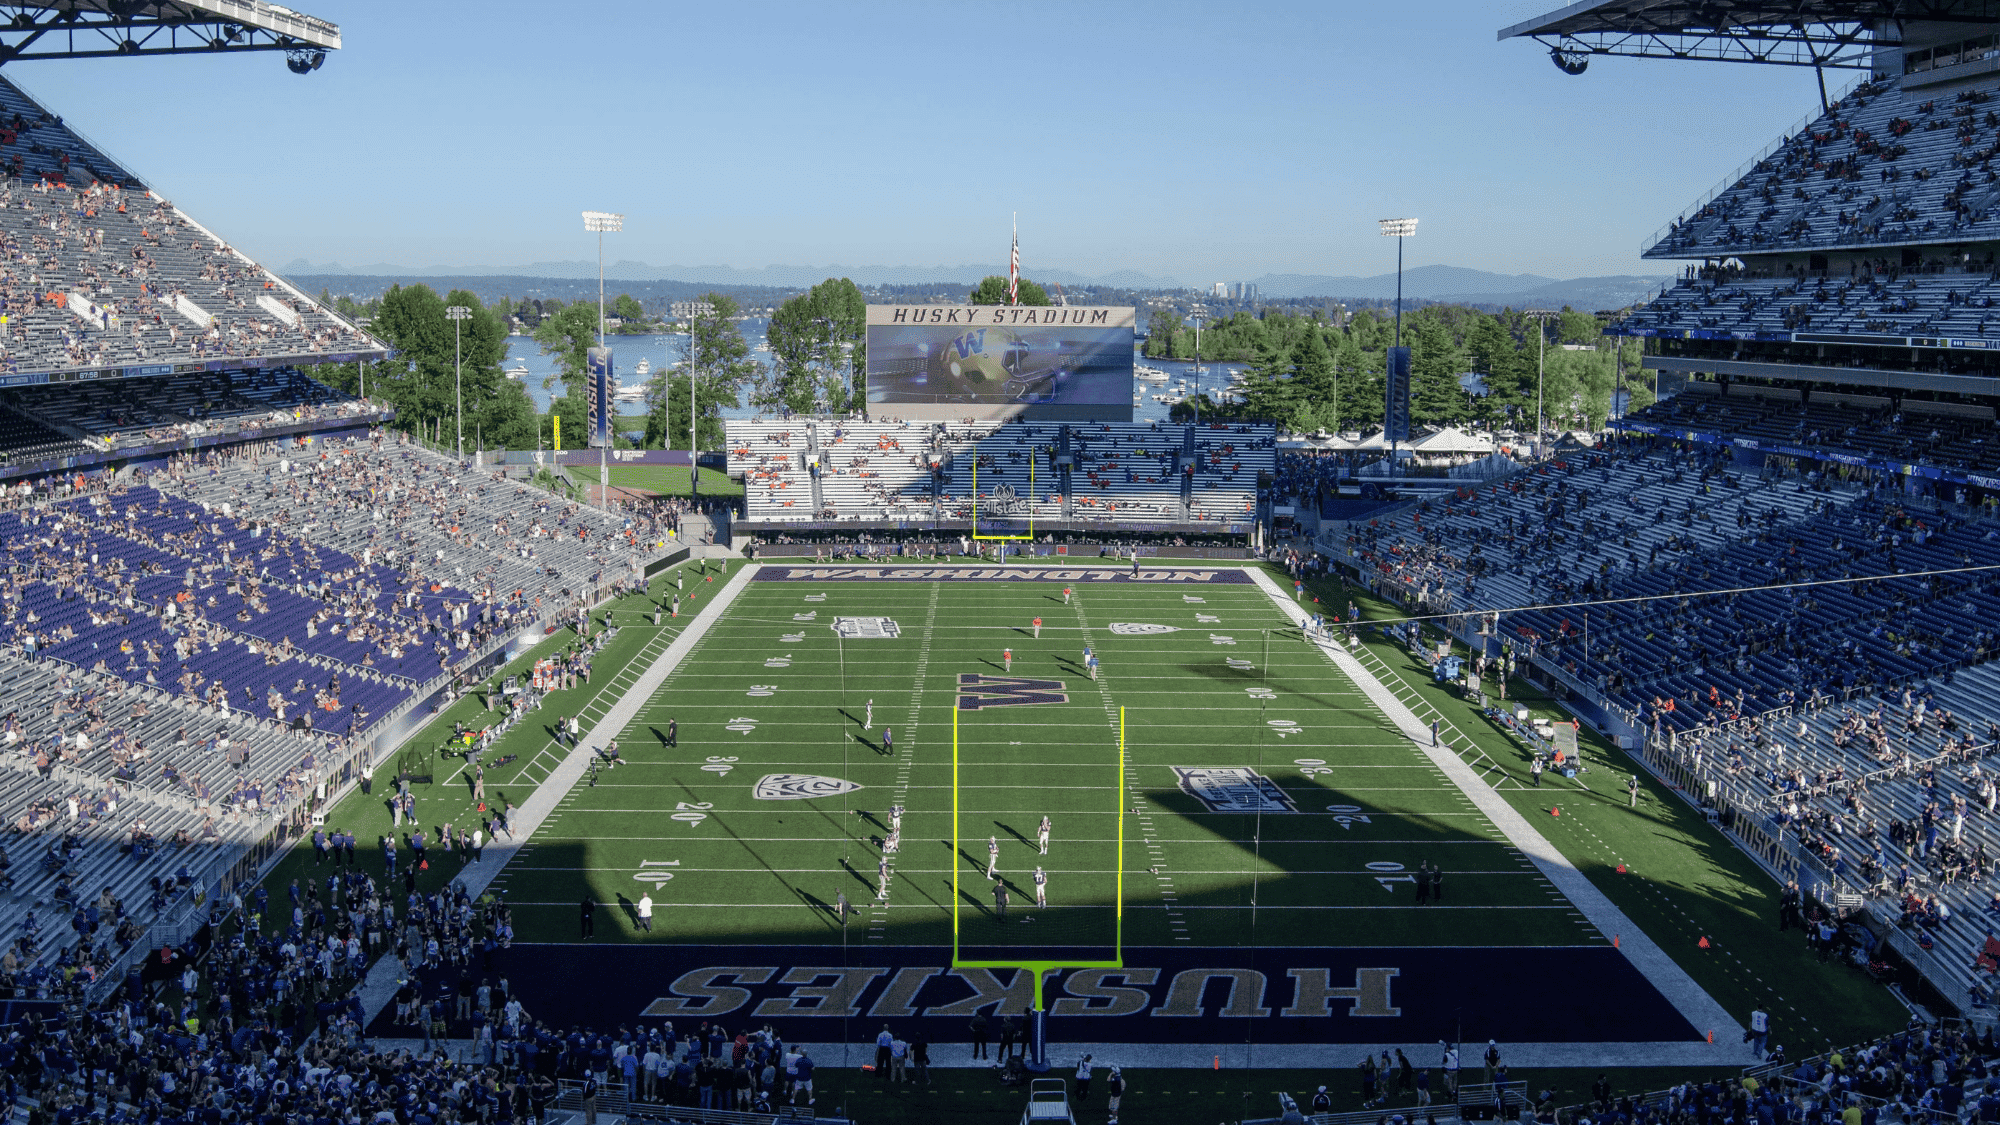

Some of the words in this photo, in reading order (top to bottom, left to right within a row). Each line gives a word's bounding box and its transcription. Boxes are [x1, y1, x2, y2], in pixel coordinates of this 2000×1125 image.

[892, 308, 979, 323] HUSKY
[992, 309, 1109, 324] STADIUM
[953, 328, 987, 360] W
[981, 499, 1027, 515] Allstate
[786, 568, 1218, 581] WASHINGTON
[746, 684, 778, 697] 50
[956, 673, 1070, 711] W
[725, 716, 760, 731] 40
[1266, 719, 1303, 735] 40
[700, 755, 739, 772] 30
[1293, 758, 1333, 775] 30
[670, 801, 713, 821] 20
[1326, 804, 1372, 824] 20
[1643, 739, 1730, 816] WASHINGTN
[1733, 812, 1801, 885] HUSKIES
[633, 859, 680, 882] 10
[1364, 861, 1417, 885] 10
[640, 965, 1401, 1017] HUSKIES
